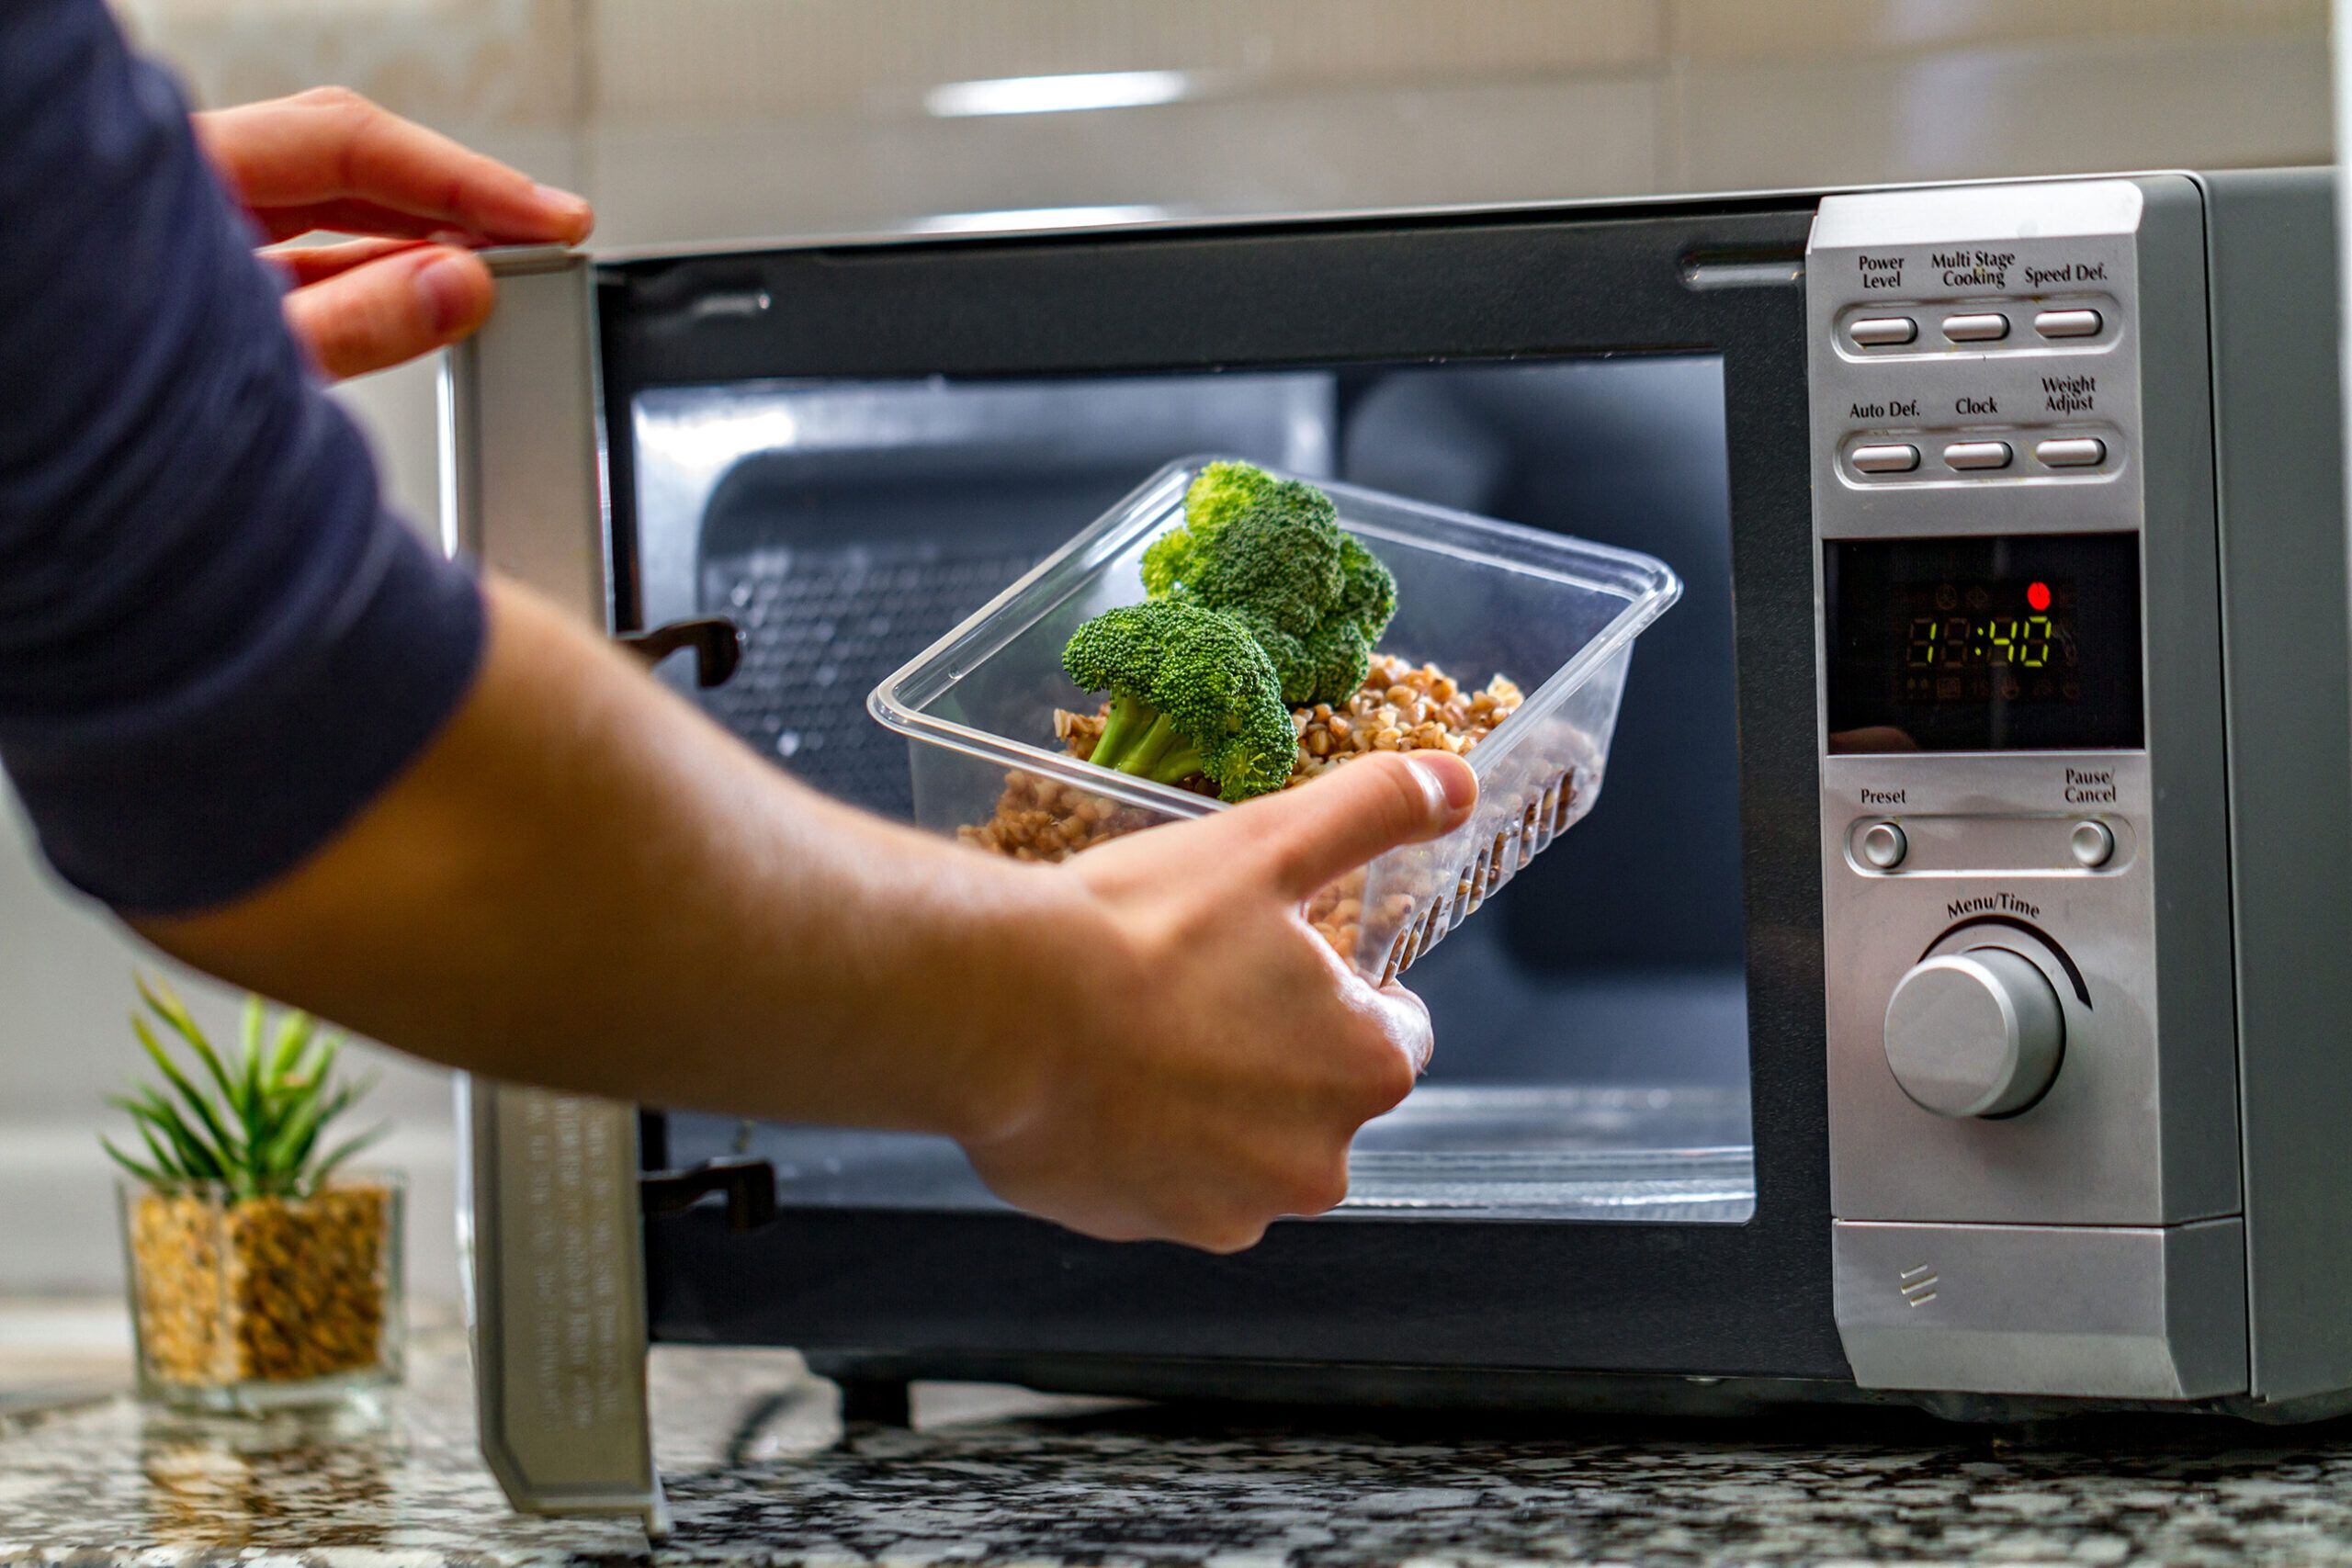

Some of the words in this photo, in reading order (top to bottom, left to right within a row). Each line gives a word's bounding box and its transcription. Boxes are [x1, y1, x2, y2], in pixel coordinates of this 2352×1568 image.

[1859, 255, 1904, 271] Power
[1932, 253, 1971, 268] Multi
[1975, 251, 2015, 270] Stage
[1863, 272, 1901, 288] Level
[1943, 270, 2005, 288] Cooking
[2025, 267, 2071, 288] Speed
[2076, 263, 2107, 280] Def.
[2041, 376, 2096, 395] Weight
[1850, 403, 1884, 418] Auto
[1890, 400, 1920, 416] Def.
[1955, 398, 1997, 414] Clock
[2045, 394, 2094, 415] Adjust
[1928, 616, 2052, 667] 1:40
[1860, 789, 1905, 804] Preset
[2064, 786, 2116, 803] Cancel
[1948, 893, 2041, 919] Menu/Time
